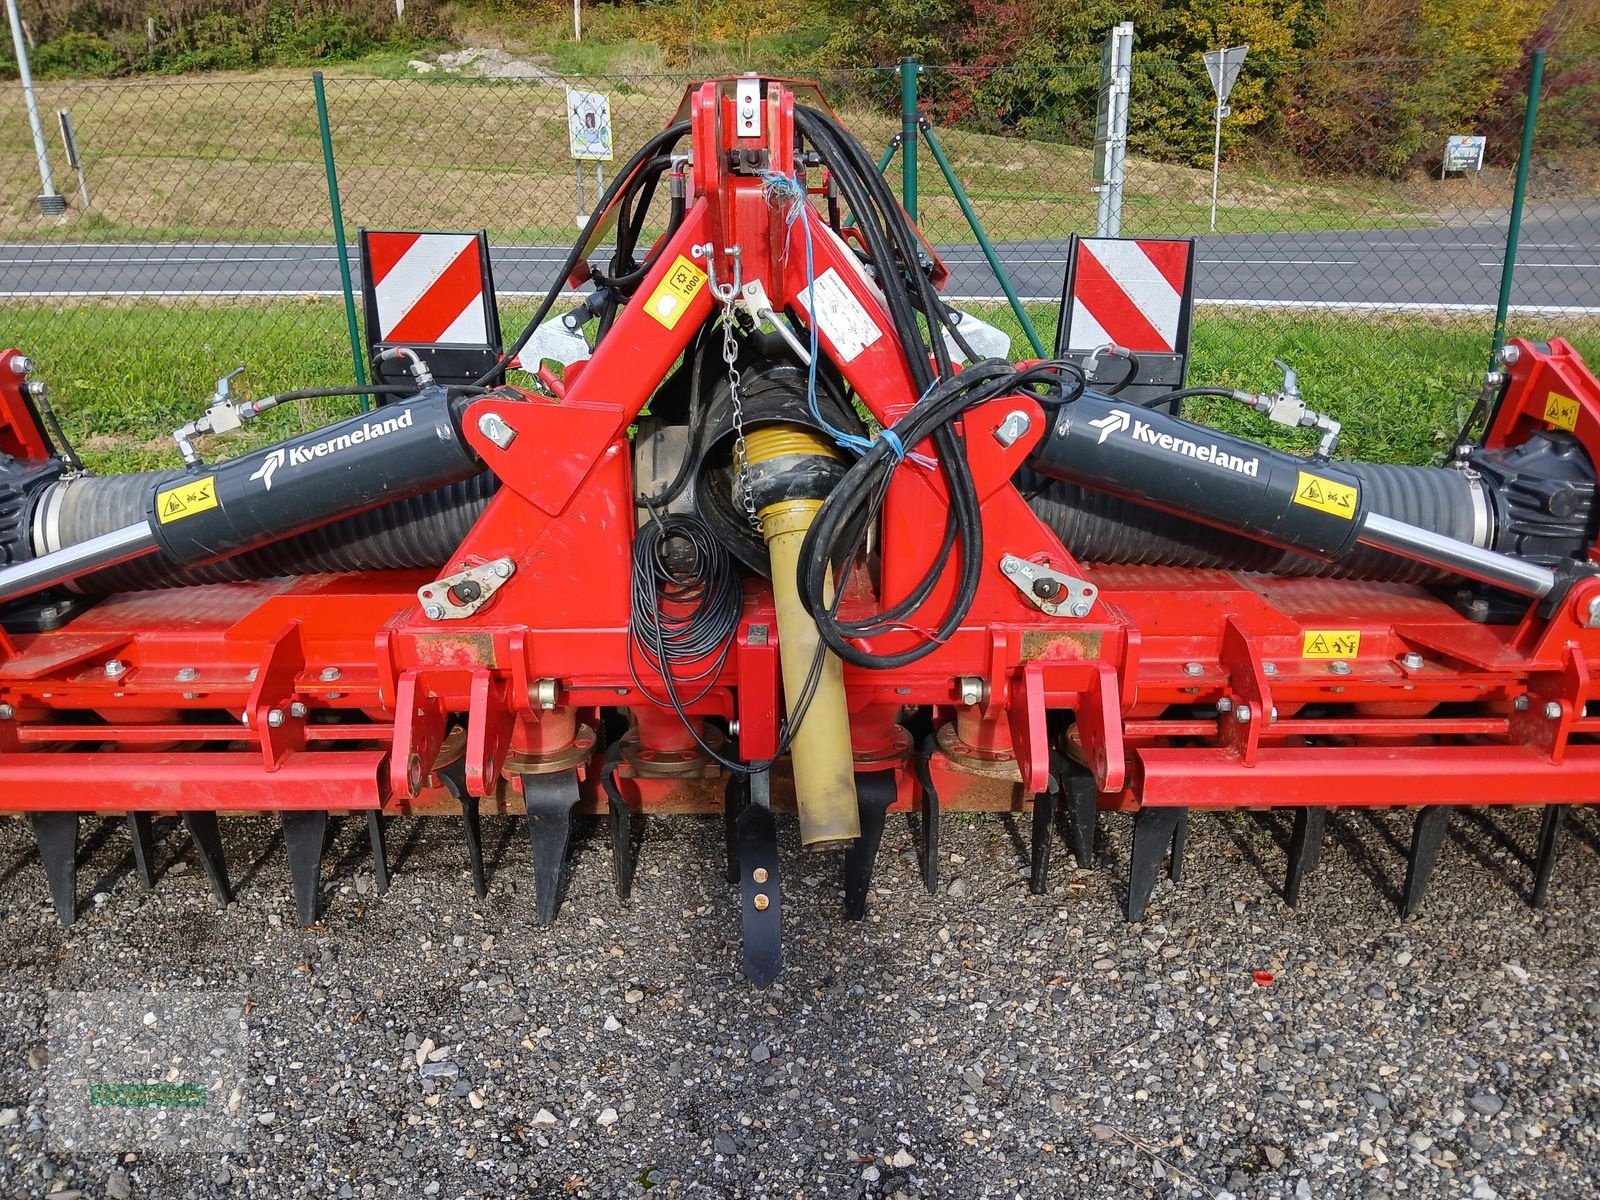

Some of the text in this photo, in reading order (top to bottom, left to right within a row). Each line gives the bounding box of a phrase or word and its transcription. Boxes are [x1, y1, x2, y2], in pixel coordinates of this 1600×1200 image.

[683, 275, 700, 295] 1000
[289, 408, 413, 467] Kverneland
[1131, 420, 1259, 477] Kverneland
